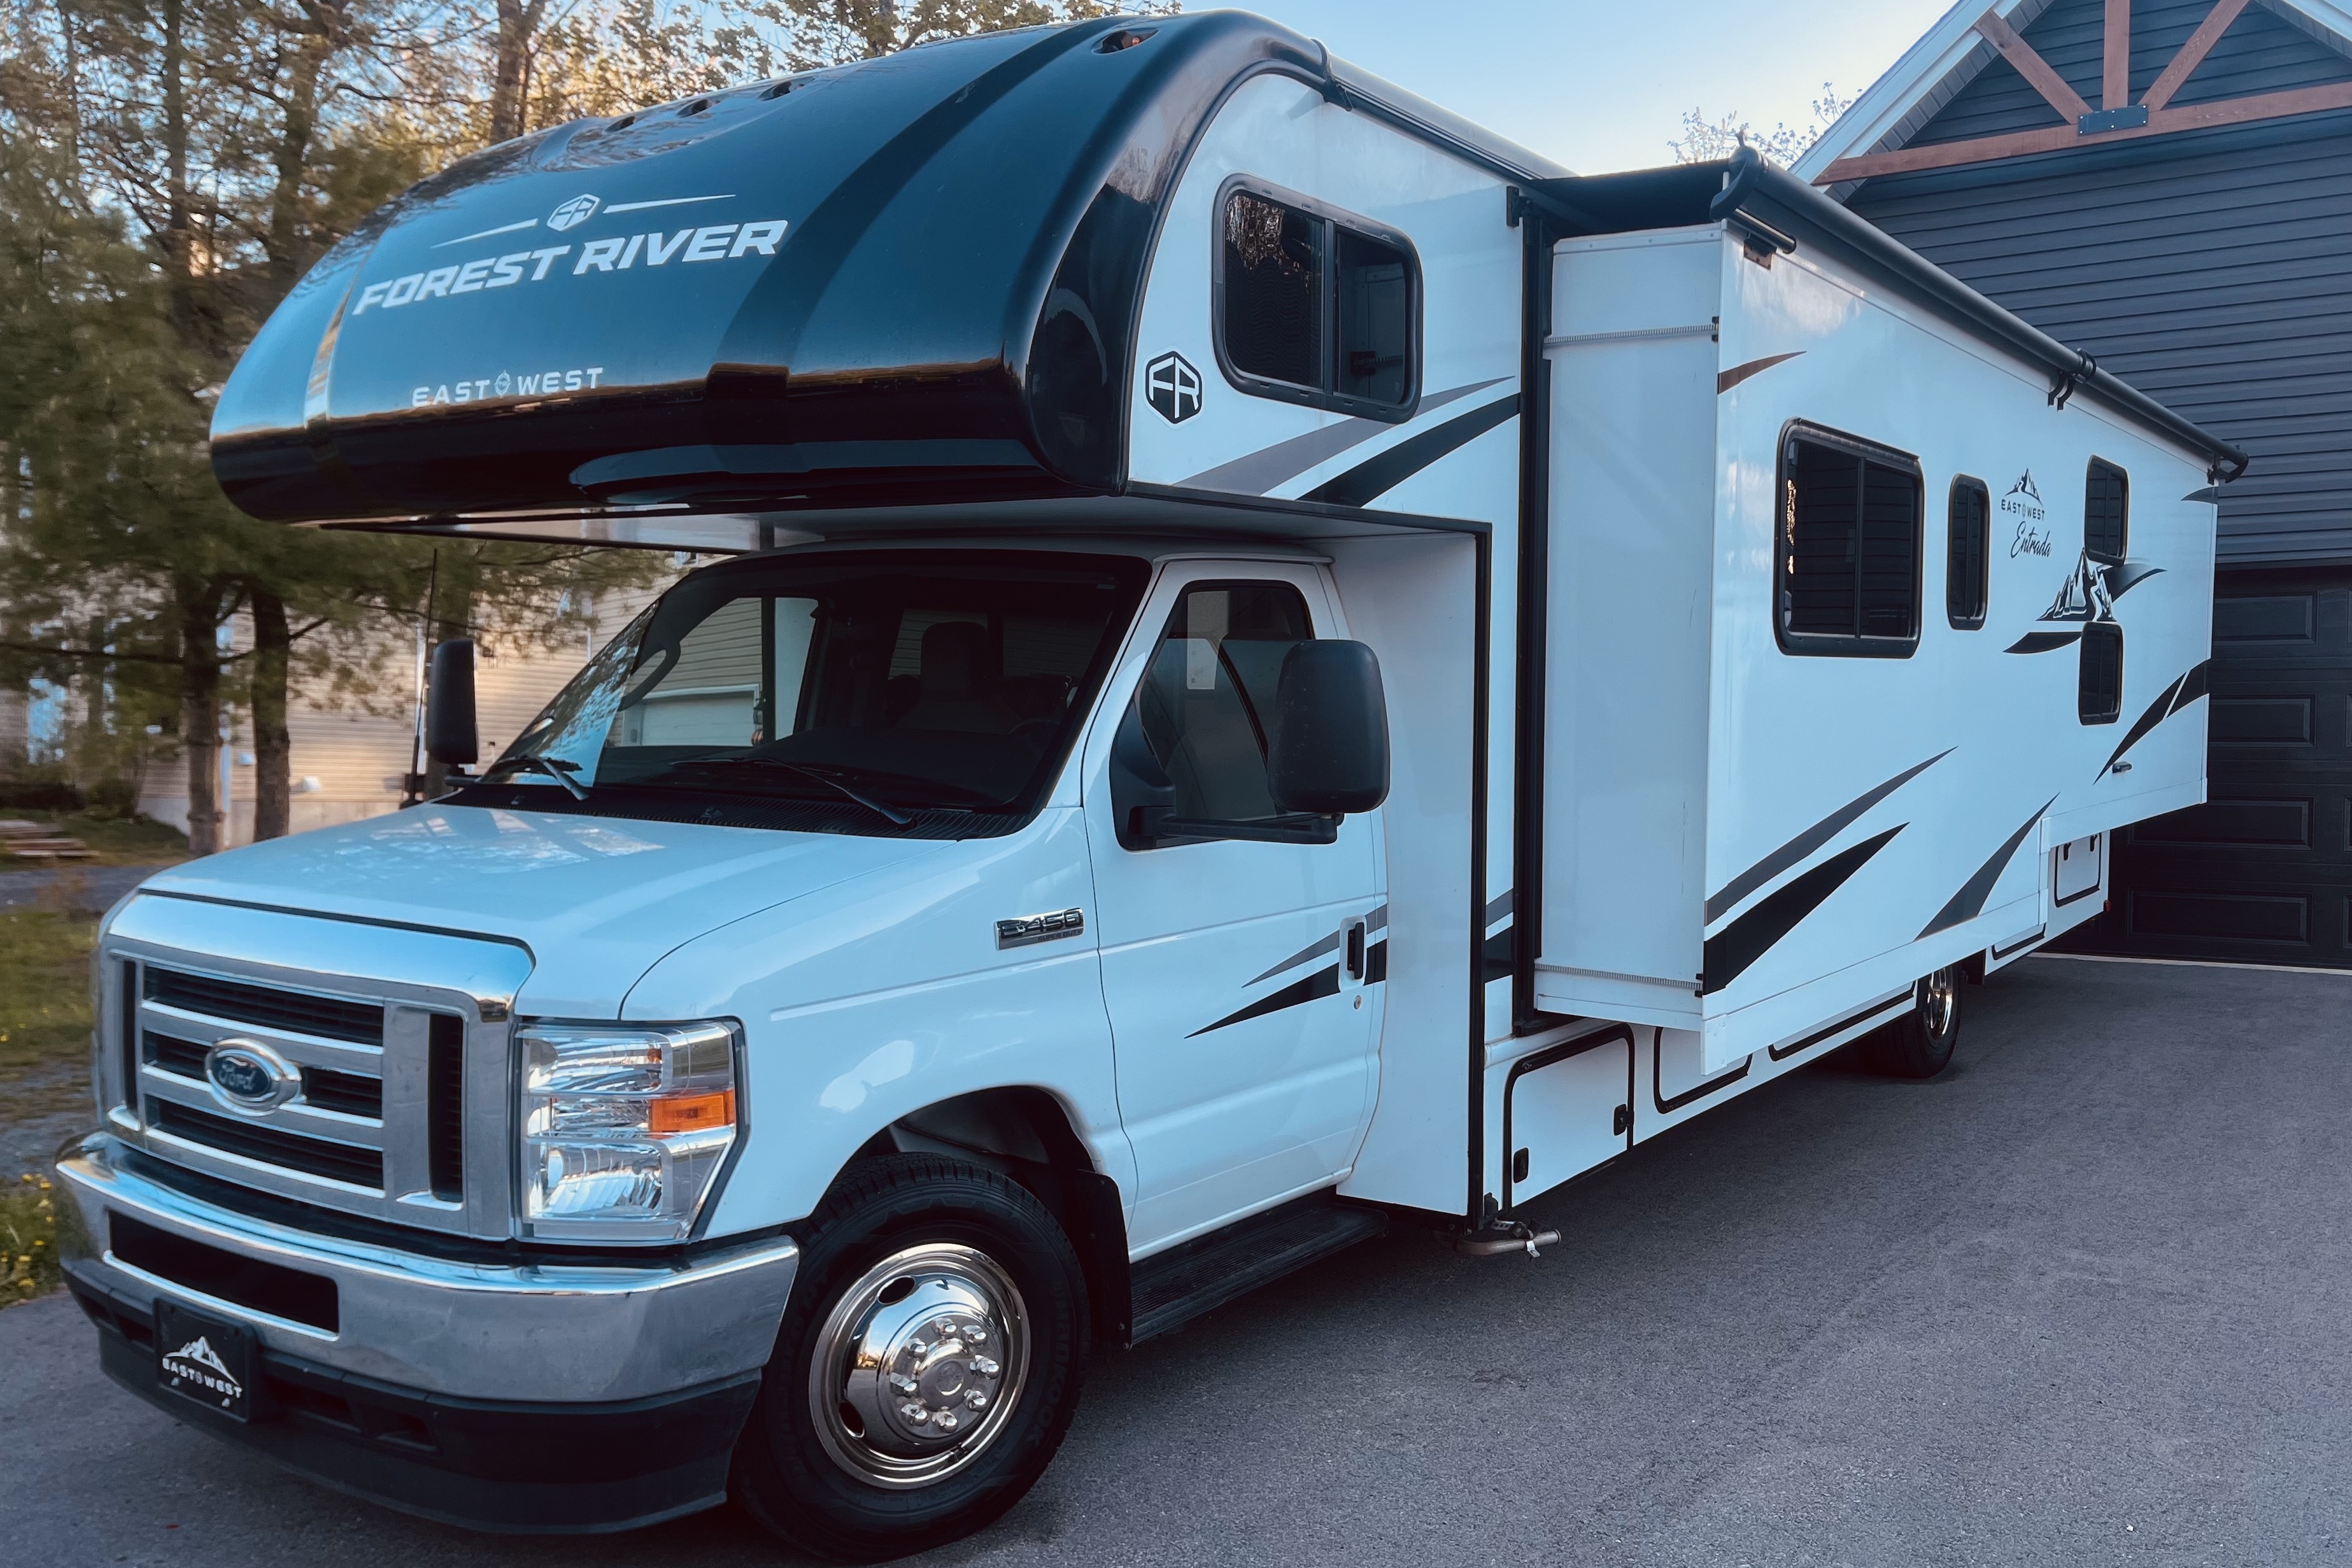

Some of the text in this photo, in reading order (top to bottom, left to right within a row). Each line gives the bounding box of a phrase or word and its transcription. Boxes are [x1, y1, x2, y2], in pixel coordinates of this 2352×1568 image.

[352, 220, 789, 315] FOREST RIVER
[411, 379, 490, 407] EAST
[517, 367, 604, 396] WEST
[2001, 499, 2045, 521] EAST WEST
[2011, 521, 2052, 558] Entrada
[218, 1064, 257, 1090] Ford
[162, 1357, 243, 1399] EAST WEST
